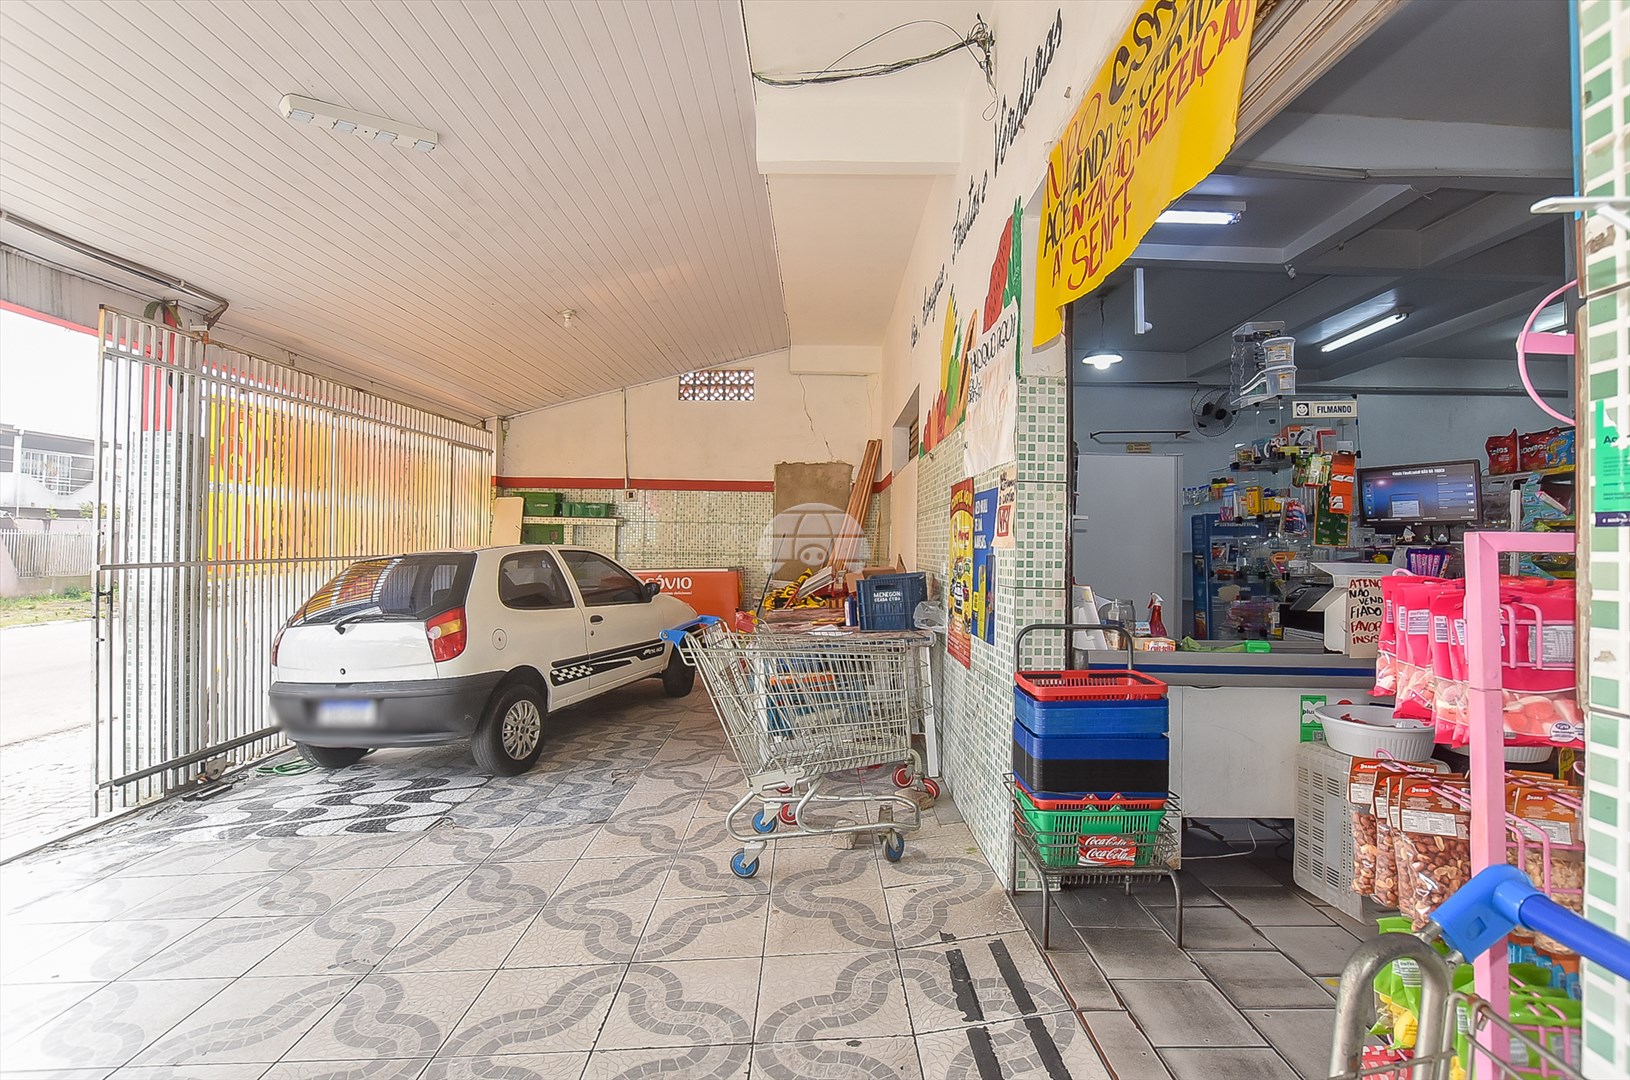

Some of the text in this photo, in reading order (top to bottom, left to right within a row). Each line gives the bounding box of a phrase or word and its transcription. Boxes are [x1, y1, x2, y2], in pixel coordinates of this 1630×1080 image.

[994, 8, 1062, 179] Verduras
[1068, 167, 1134, 290] SENFF
[1316, 405, 1352, 414] FILMANDO
[1349, 579, 1382, 590] ATENÇ
[1359, 596, 1383, 605] VEND
[1350, 604, 1382, 619] FIADO
[1353, 633, 1379, 645] INSIS
[1086, 847, 1130, 860] Coca-Cola
